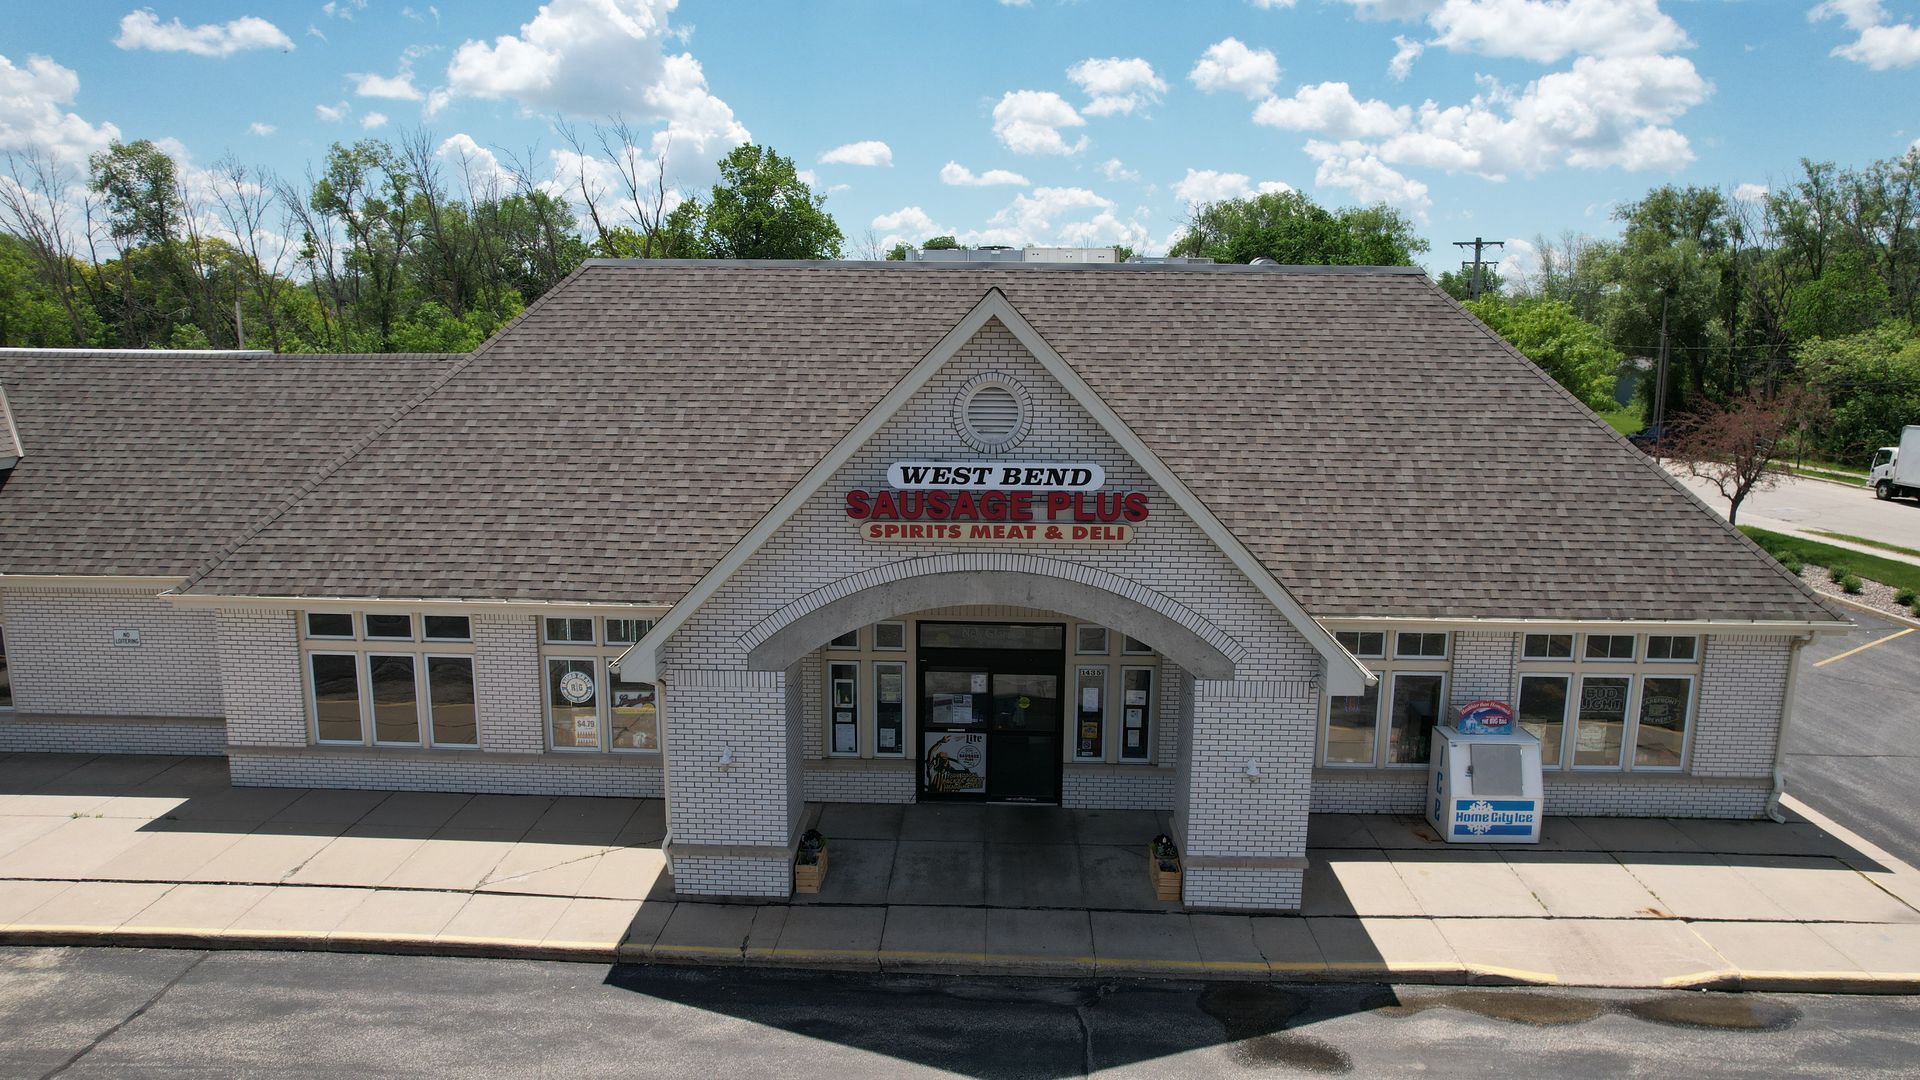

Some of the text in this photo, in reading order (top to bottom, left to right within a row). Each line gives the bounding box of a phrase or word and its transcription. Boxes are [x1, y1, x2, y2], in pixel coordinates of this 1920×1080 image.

[900, 466, 1093, 486] WEST BEND
[846, 490, 1149, 522] SAUSAGE PLUS
[869, 524, 1125, 541] SPIRITS MEAT & DELI
[1081, 669, 1103, 677] 1435
[1585, 687, 1618, 699] BUD
[1580, 698, 1623, 711] LIGHT
[966, 734, 982, 744] Lite
[1456, 812, 1533, 825] Home City Ice
